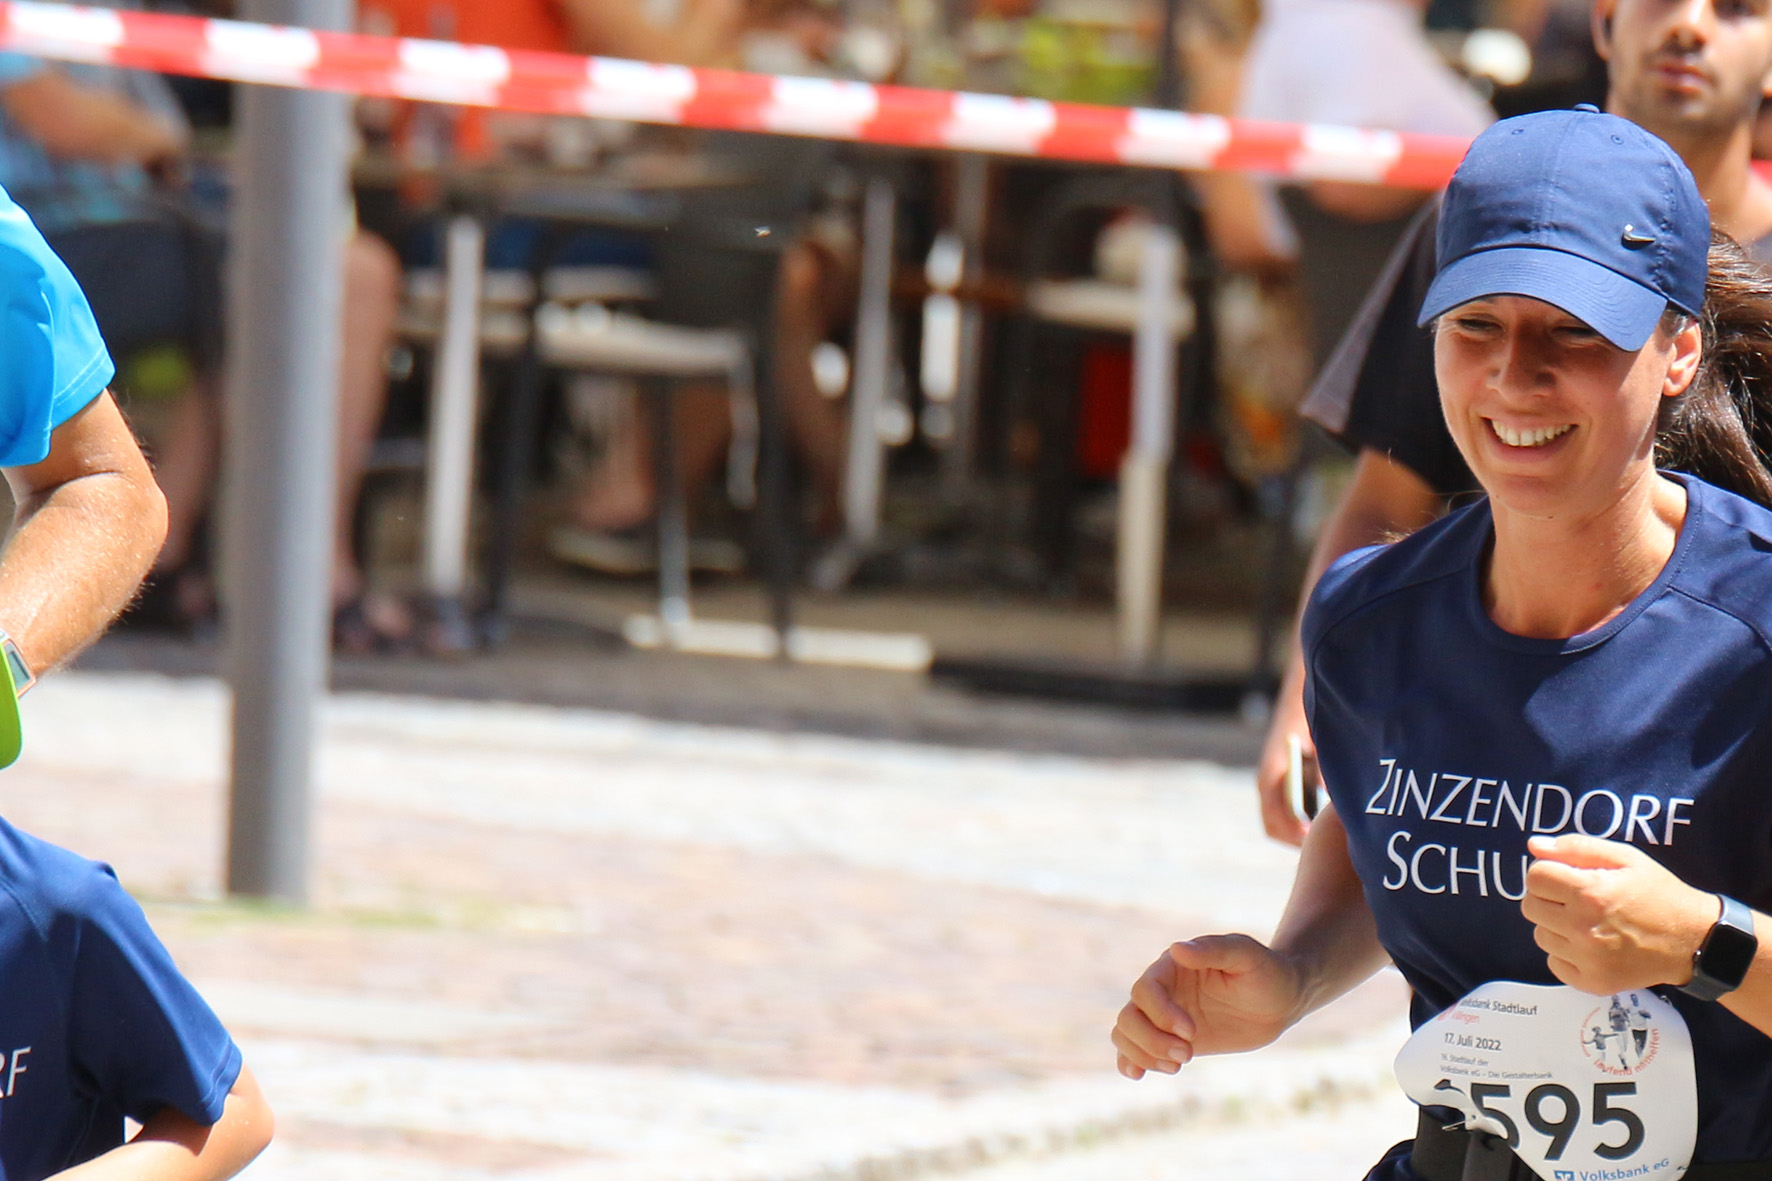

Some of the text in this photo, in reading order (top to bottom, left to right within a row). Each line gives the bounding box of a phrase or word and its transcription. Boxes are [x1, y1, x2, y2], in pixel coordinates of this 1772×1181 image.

[1365, 758, 1695, 846] ZINZENDORF
[1383, 831, 1528, 901] SCHU
[1492, 1001, 1538, 1015] Stadtlauf
[1458, 1034, 1473, 1047] Juli
[1475, 1037, 1502, 1051] 2022
[1434, 1079, 1645, 1161] 595
[1580, 1158, 1670, 1181] Volksbank eG
